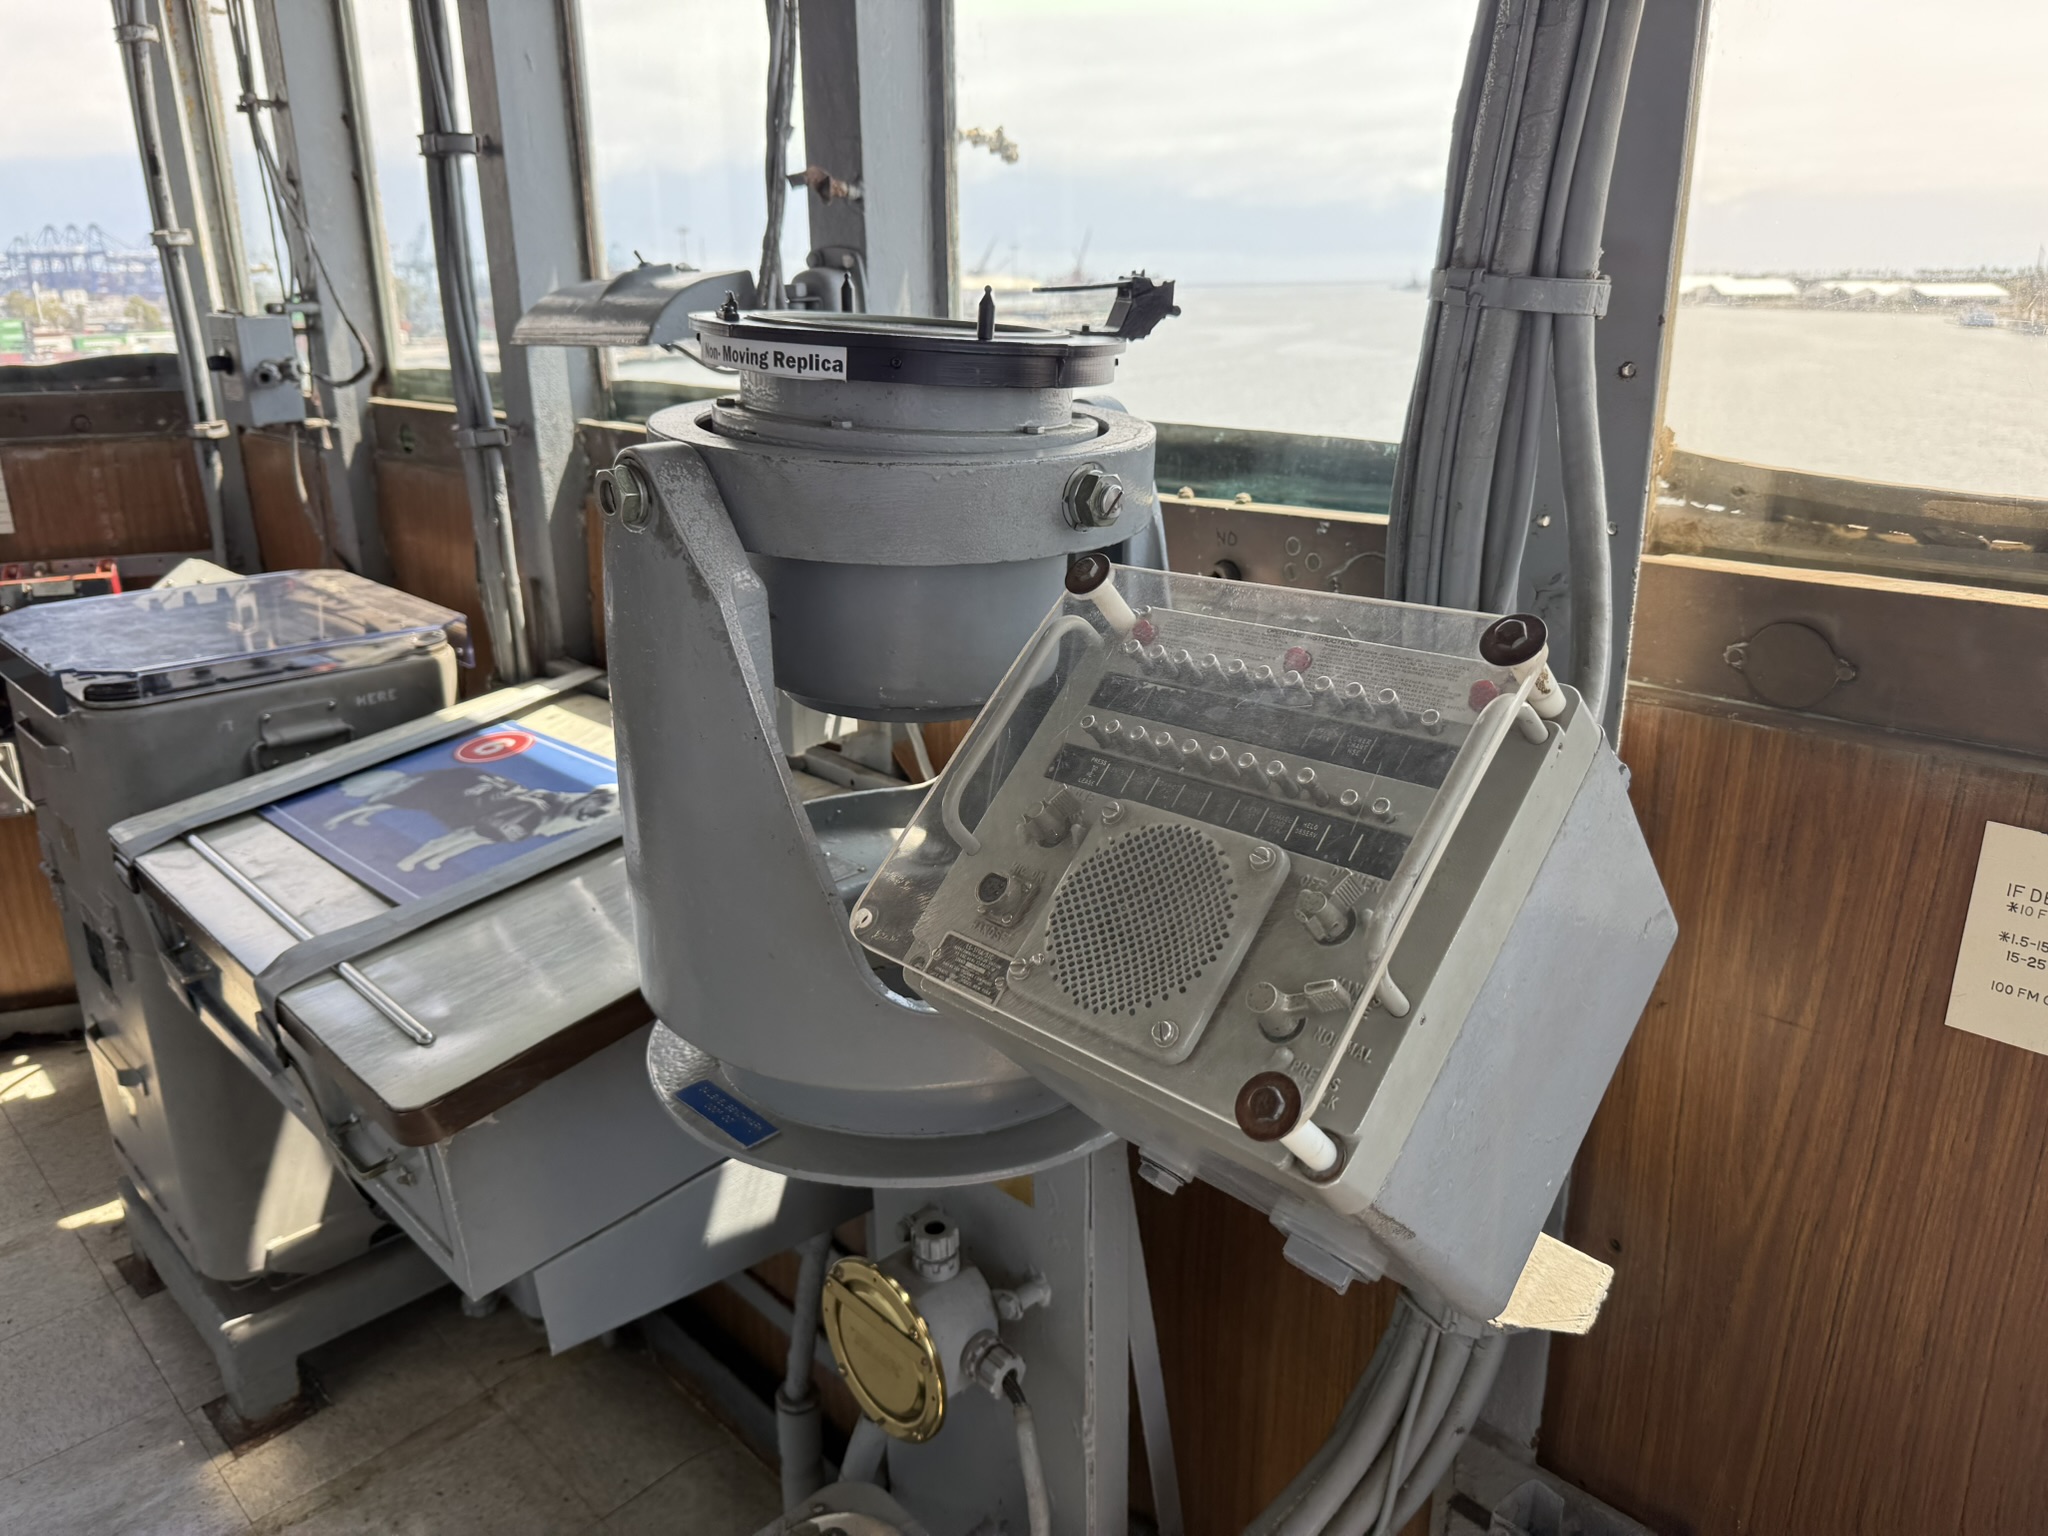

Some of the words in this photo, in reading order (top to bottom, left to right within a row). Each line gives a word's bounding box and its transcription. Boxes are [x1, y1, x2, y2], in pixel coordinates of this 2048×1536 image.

[723, 345, 769, 370] Moving
[773, 350, 844, 374] Replica
[1090, 756, 1108, 766] PRESS
[2006, 882, 2026, 898] IF
[2006, 950, 2047, 970] 15-25
[1991, 980, 2014, 995] 100
[2017, 987, 2039, 1003] FM
[1290, 1060, 1341, 1092] PRES
